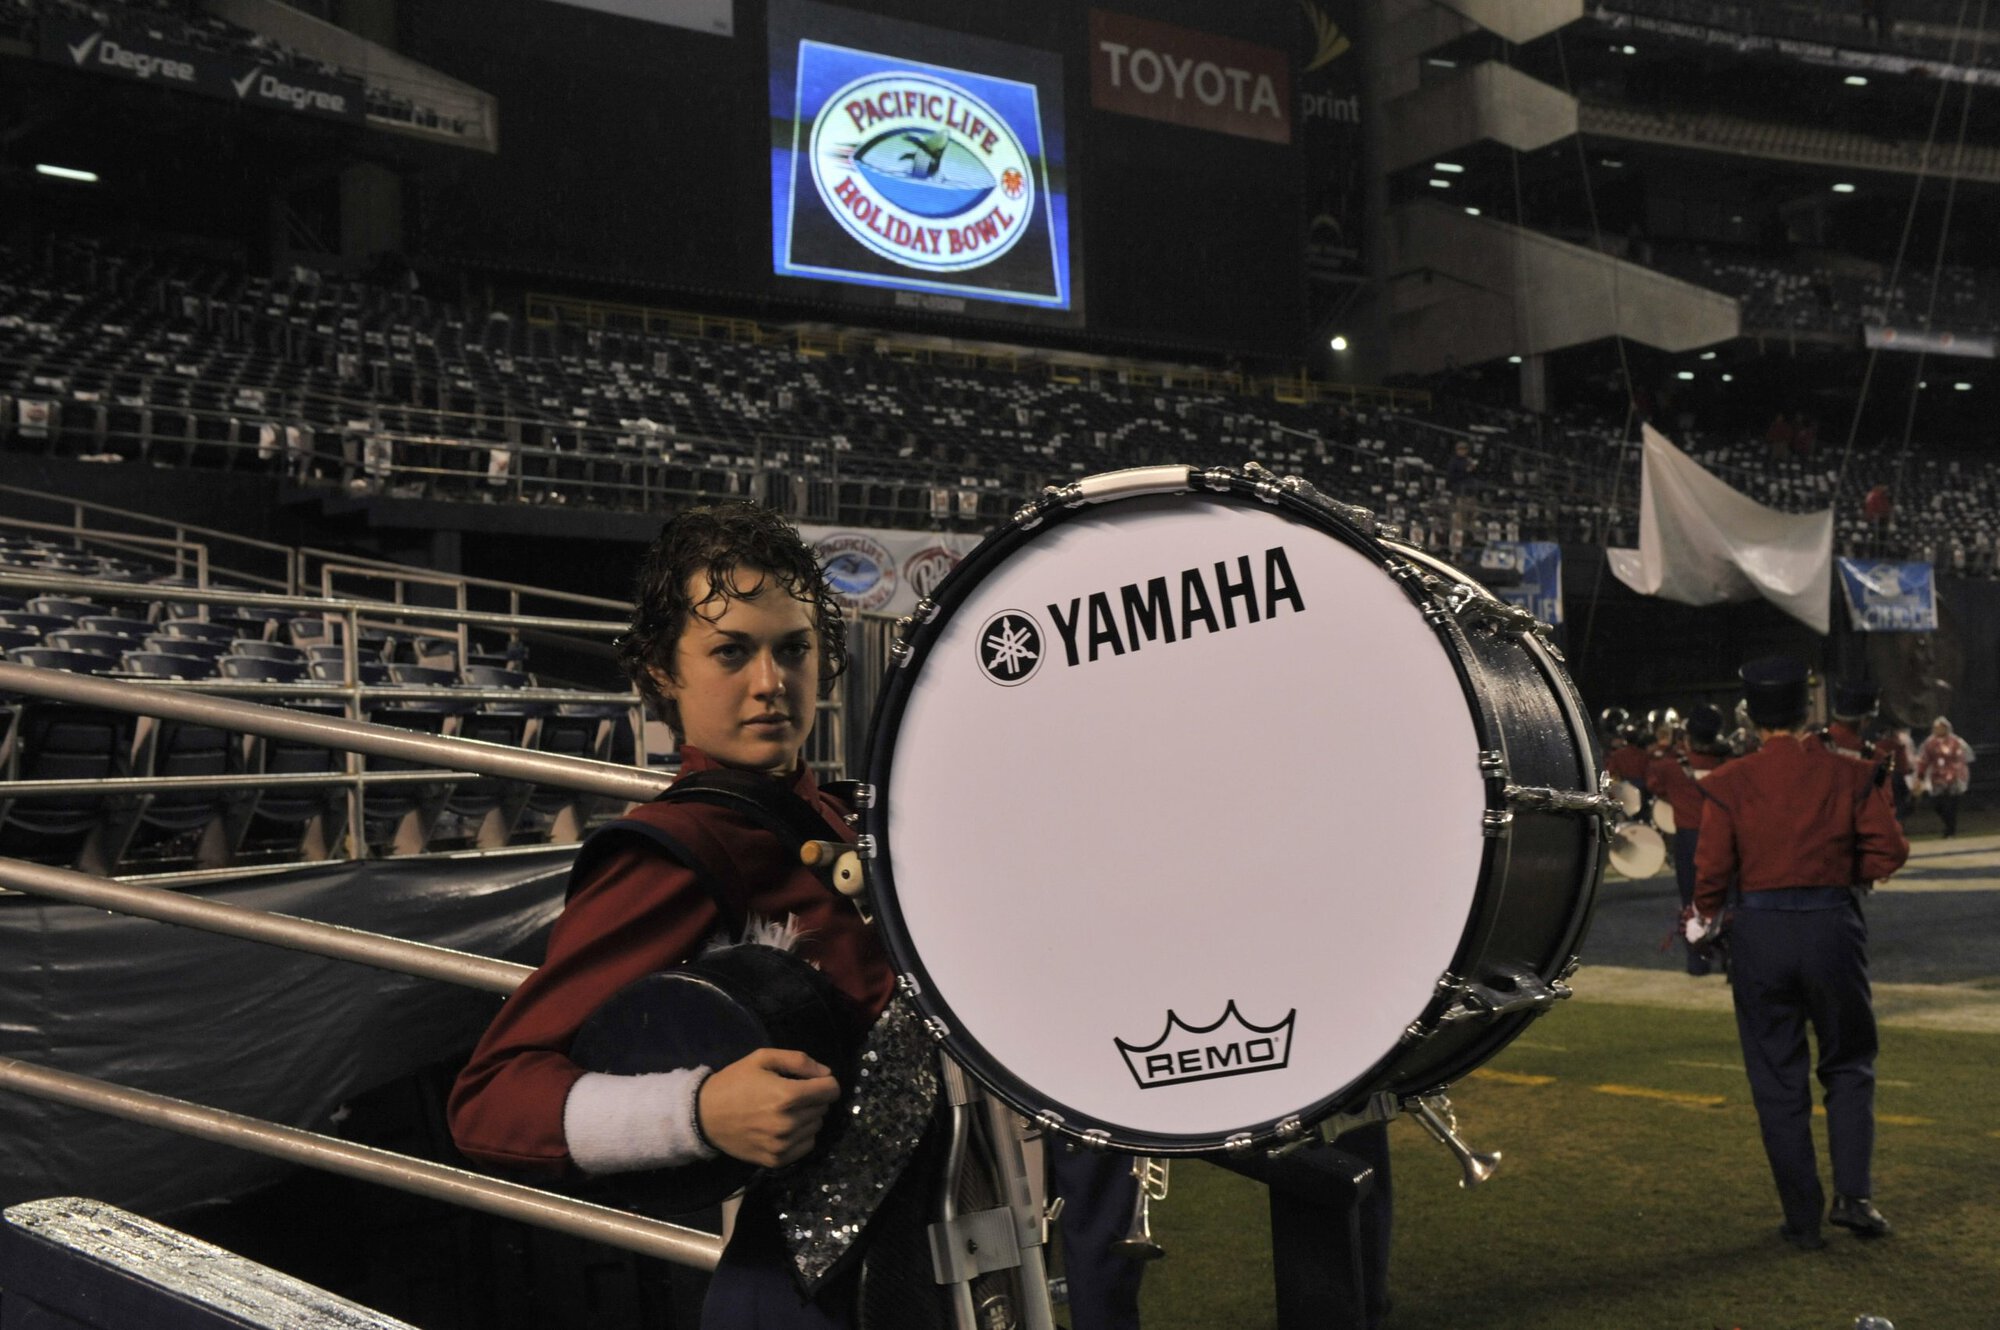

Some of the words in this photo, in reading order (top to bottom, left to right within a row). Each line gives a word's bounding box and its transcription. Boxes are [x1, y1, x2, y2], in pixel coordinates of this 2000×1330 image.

[99, 40, 196, 81] Degree
[259, 74, 346, 112] Degree
[1100, 41, 1282, 119] TOYOTA
[845, 90, 943, 133] PACIFIC
[945, 96, 999, 156] LIFE
[834, 176, 942, 255] HOLIDAY
[948, 206, 1015, 255] BOWL
[1047, 546, 1305, 667] YAMAHA
[1146, 1037, 1274, 1078] REMO
